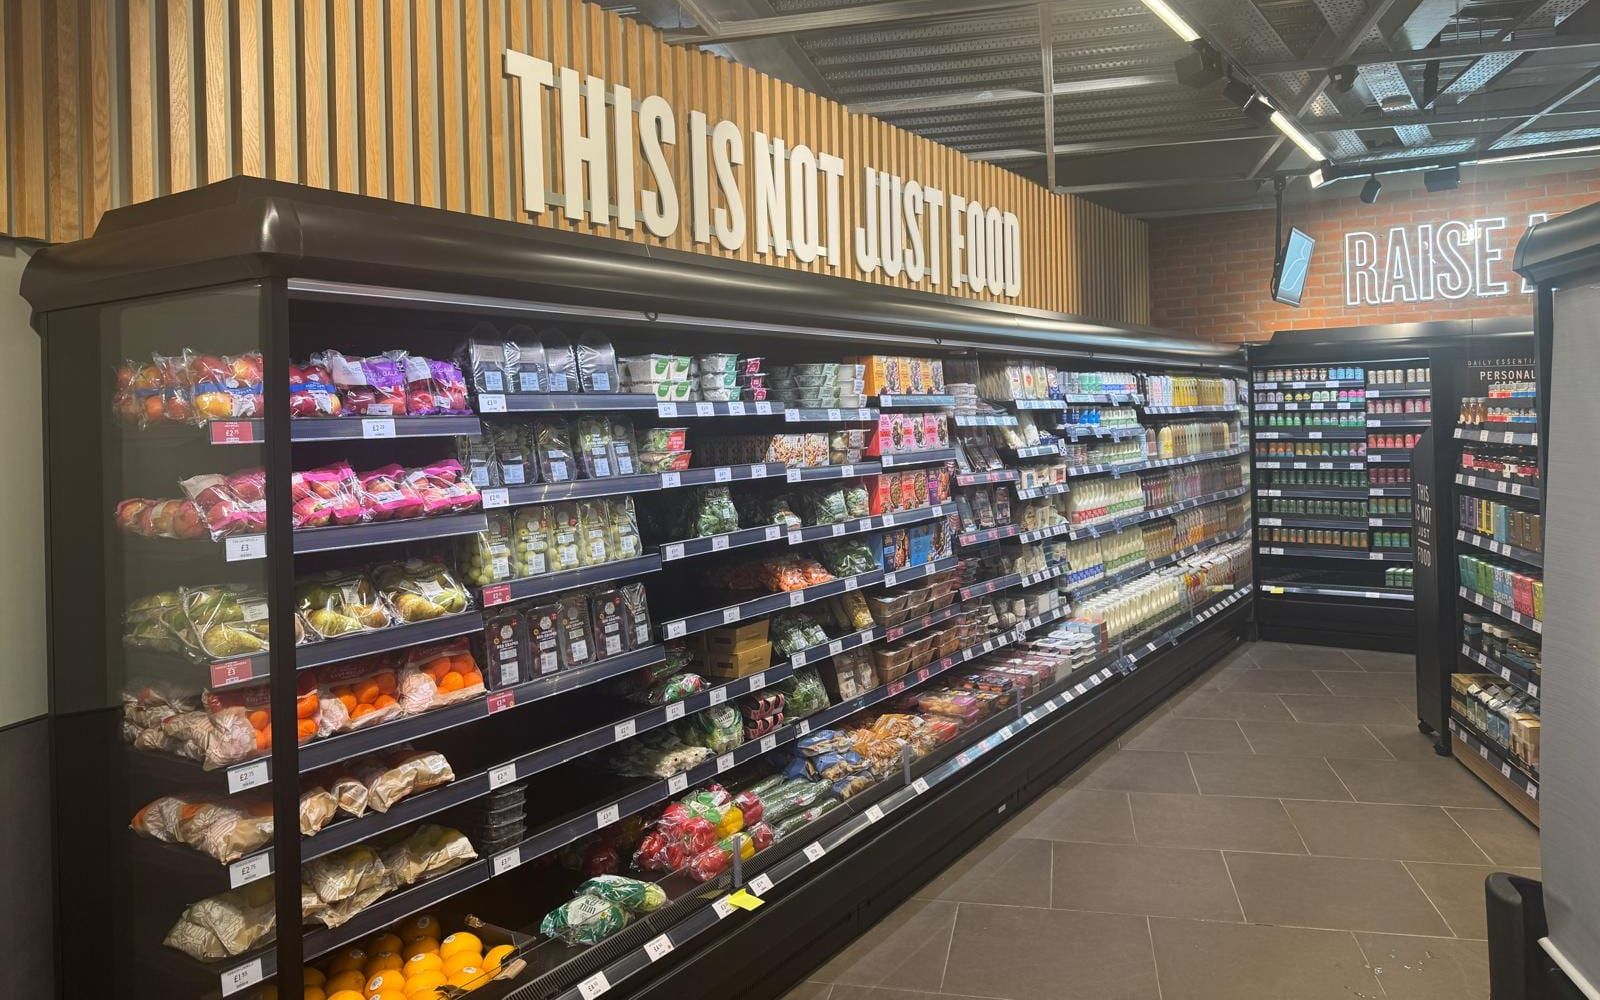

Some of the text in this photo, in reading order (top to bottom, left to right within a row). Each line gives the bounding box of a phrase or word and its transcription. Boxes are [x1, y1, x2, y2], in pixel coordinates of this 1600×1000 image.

[504, 49, 1022, 298] THIS IS NOT JUST FOOD
[1345, 217, 1508, 305] RAISE
[1480, 370, 1536, 381] PERSONAL
[1417, 484, 1430, 503] THIS
[1415, 503, 1432, 525] IS NOT
[1418, 526, 1430, 539] JUST
[1417, 546, 1431, 567] FOOD
